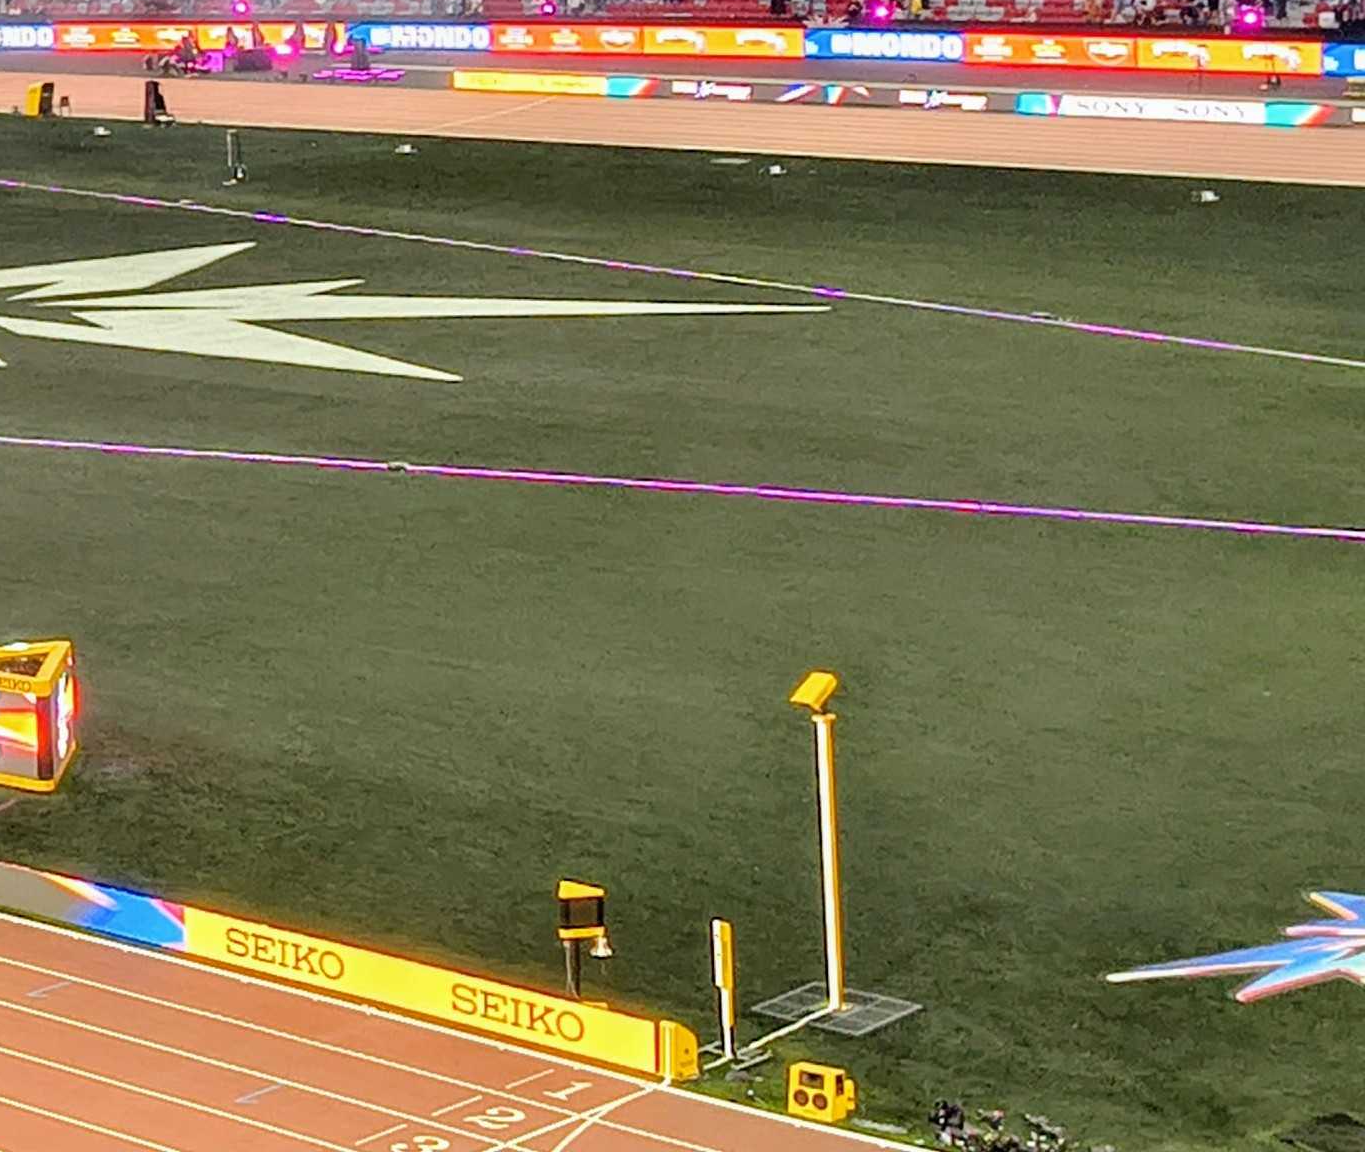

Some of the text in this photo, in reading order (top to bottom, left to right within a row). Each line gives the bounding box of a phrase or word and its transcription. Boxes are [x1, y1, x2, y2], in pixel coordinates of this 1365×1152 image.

[852, 32, 963, 59] MONDO
[1076, 99, 1245, 119] SONY SONY
[226, 927, 345, 981] SEIKO
[451, 983, 585, 1043] SEIKO
[543, 1081, 593, 1100] 1
[463, 1106, 526, 1129] 2
[390, 1135, 450, 1152] 3
